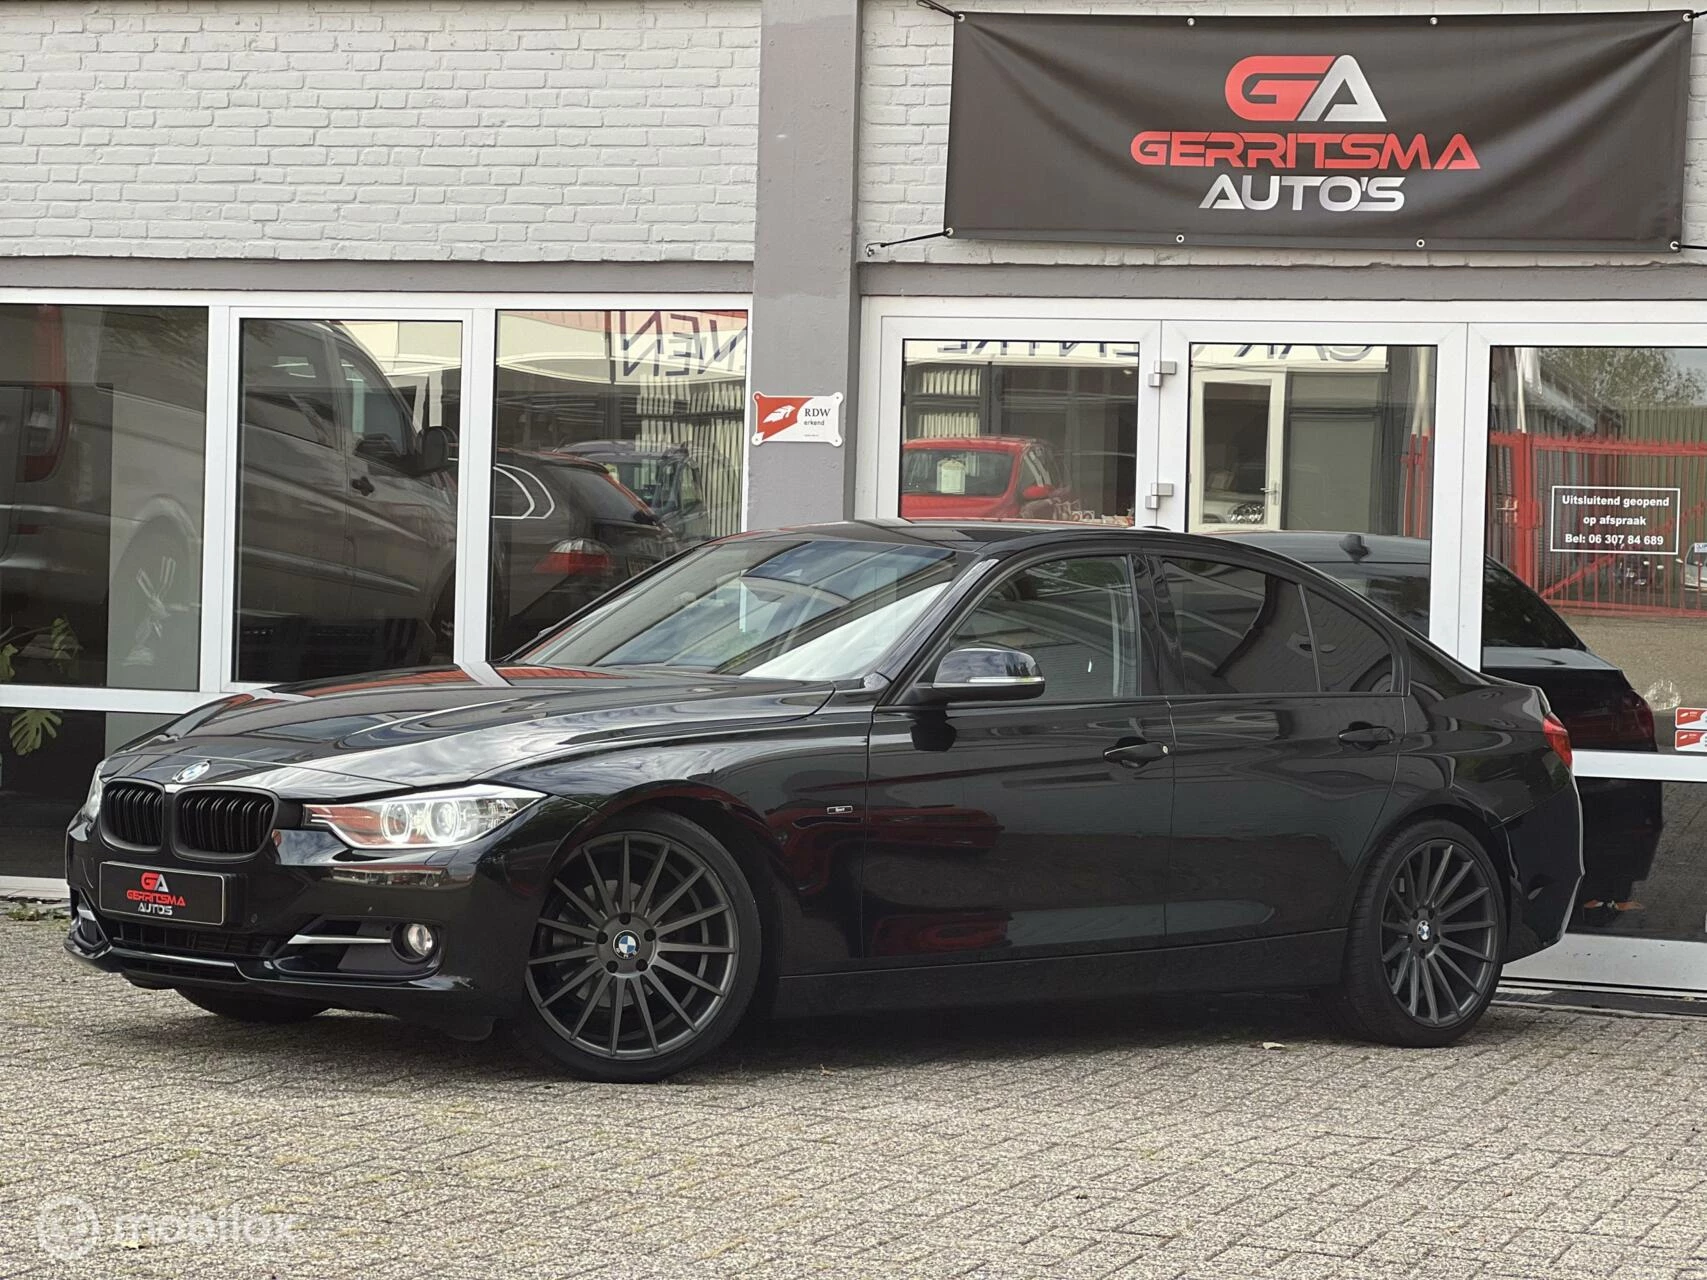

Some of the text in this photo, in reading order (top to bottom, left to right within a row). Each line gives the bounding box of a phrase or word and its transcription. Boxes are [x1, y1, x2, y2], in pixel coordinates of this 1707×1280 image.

[1224, 54, 1387, 122] GA
[1129, 130, 1481, 171] GERRITSMA
[1199, 174, 1406, 212] AUTO'S
[805, 408, 831, 417] RDW
[1562, 494, 1670, 508] Uitsluitend geopend
[1583, 515, 1647, 527] op afspraak
[1565, 533, 1664, 546] Bel: 06 307 84 689
[141, 872, 169, 892] GA
[127, 890, 186, 906] GERRITSMA
